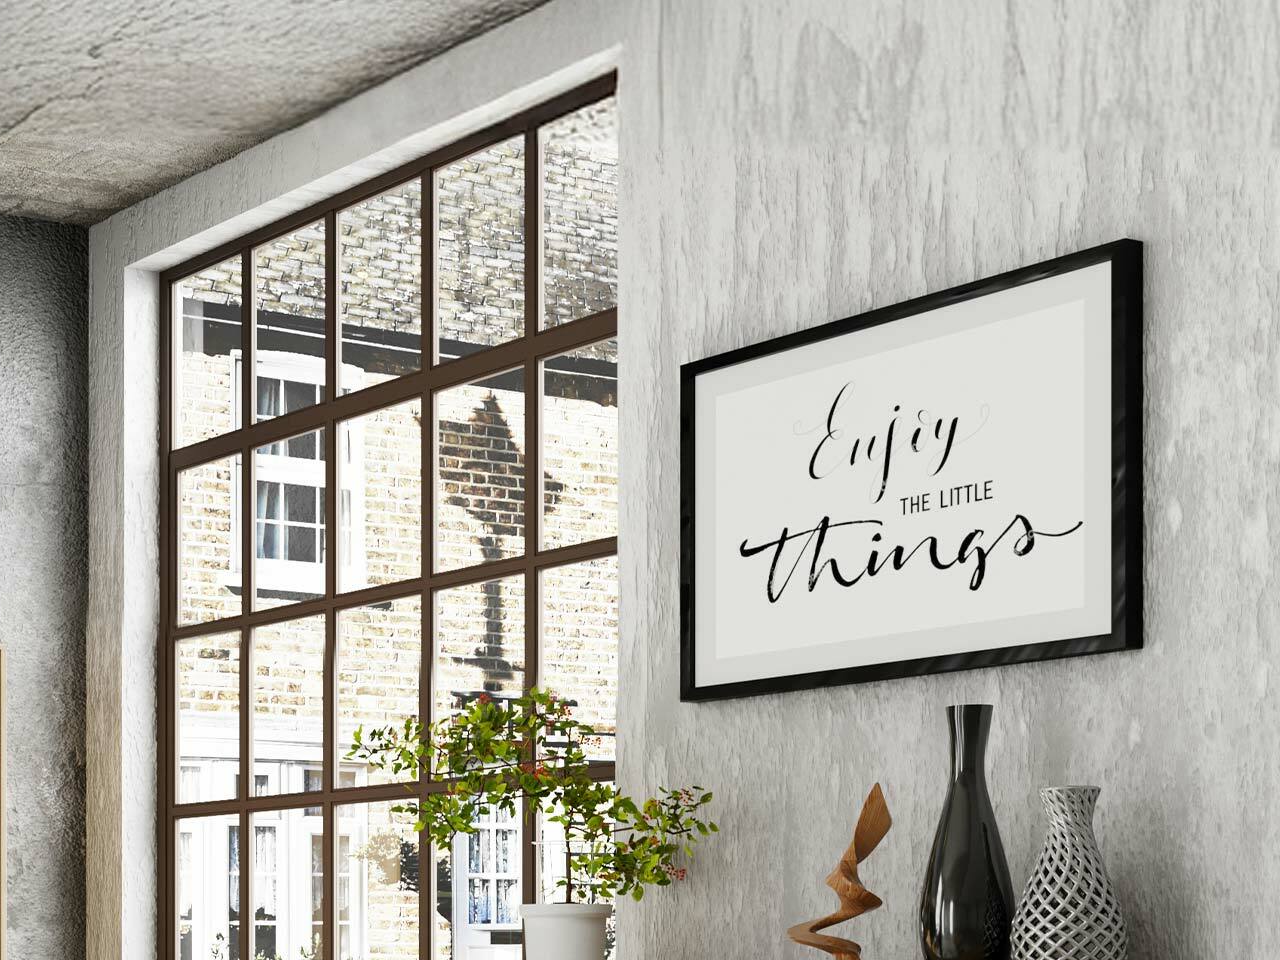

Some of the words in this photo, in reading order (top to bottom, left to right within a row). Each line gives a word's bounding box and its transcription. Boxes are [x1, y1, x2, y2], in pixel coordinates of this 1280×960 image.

[800, 381, 970, 504] Enjoy
[899, 492, 931, 516] THE
[939, 479, 994, 509] LITTLE
[739, 515, 1084, 604] things
